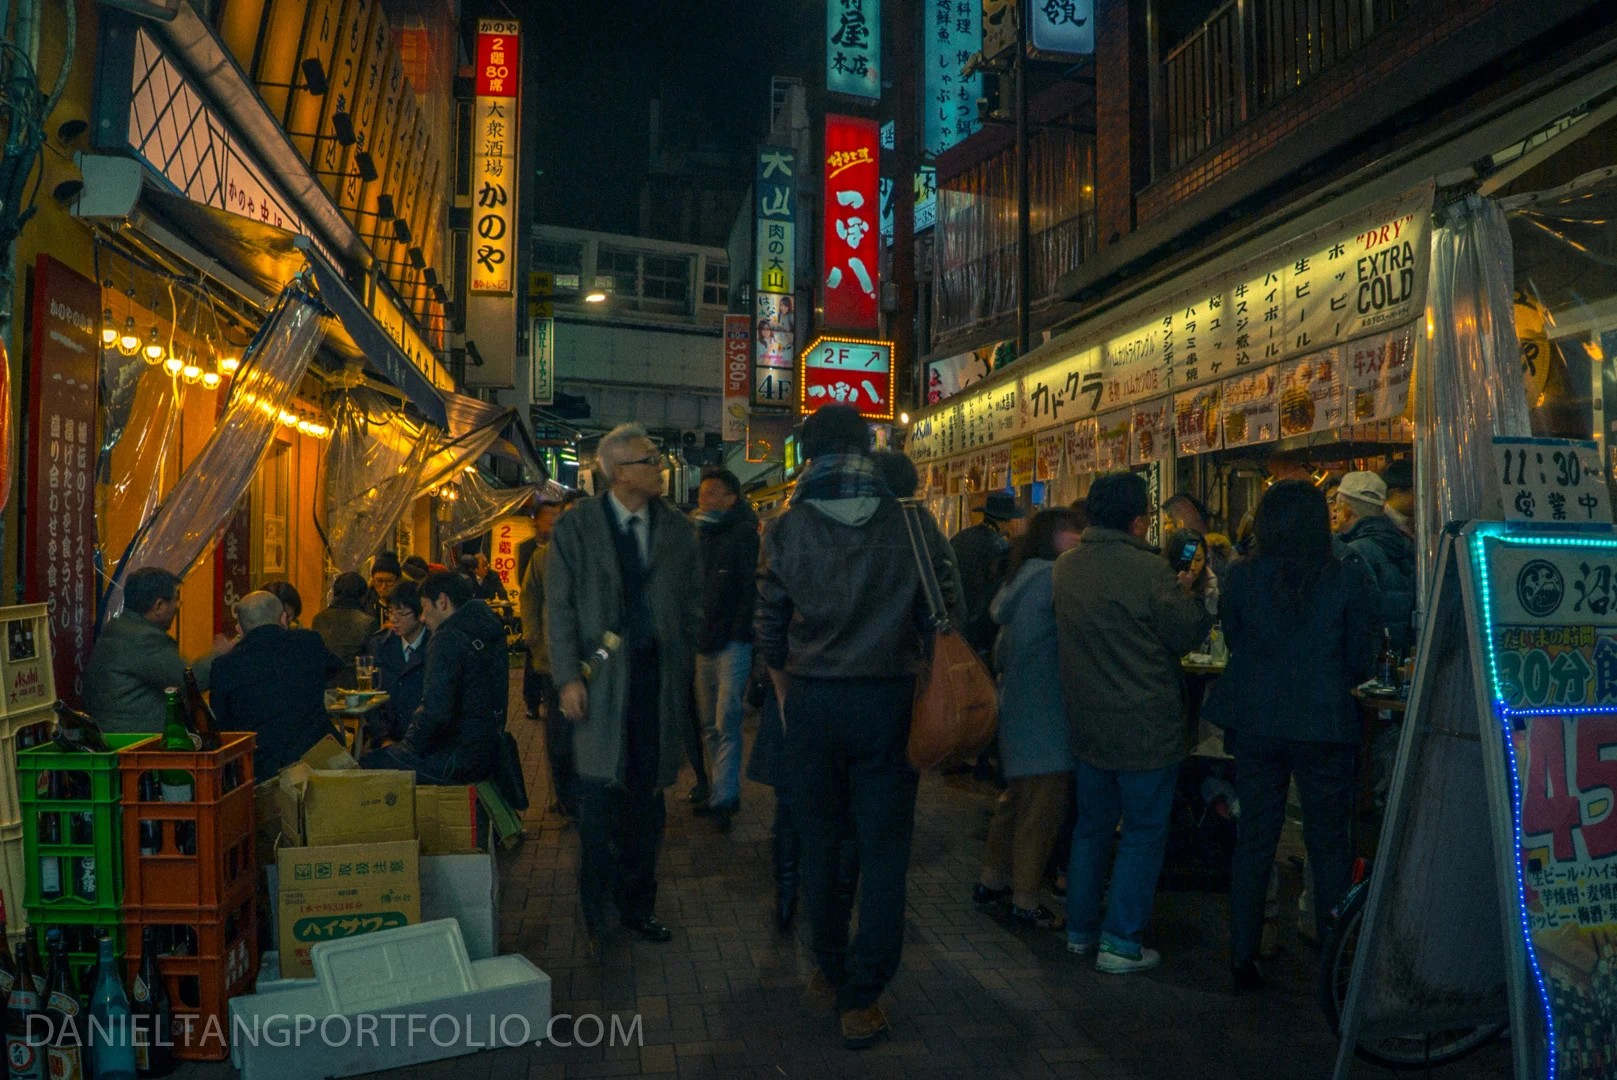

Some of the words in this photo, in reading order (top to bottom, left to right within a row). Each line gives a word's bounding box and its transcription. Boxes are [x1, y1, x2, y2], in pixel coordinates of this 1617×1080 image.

[485, 100, 506, 177] 大衆酒場
[761, 151, 794, 217] 大山
[478, 181, 508, 274] かのや
[768, 224, 785, 289] 肉の大山
[827, 190, 874, 298] つぼ八
[1357, 240, 1415, 283] EXTRA
[1357, 267, 1415, 314] COLD
[1209, 294, 1223, 374] 桜ユッケ
[1234, 283, 1251, 367] 牛スジ煮込
[1264, 272, 1280, 358] ハイボール
[1294, 257, 1311, 348] 生ビール
[824, 347, 851, 365] 2F
[1163, 316, 1174, 389] タンシチュー
[758, 374, 793, 401] 4F
[807, 379, 881, 405] つぼ八
[1031, 371, 1104, 420] カドクラ
[1514, 489, 1600, 520] 営業中
[1573, 561, 1617, 617] 沼
[302, 916, 399, 937] ハイサワー
